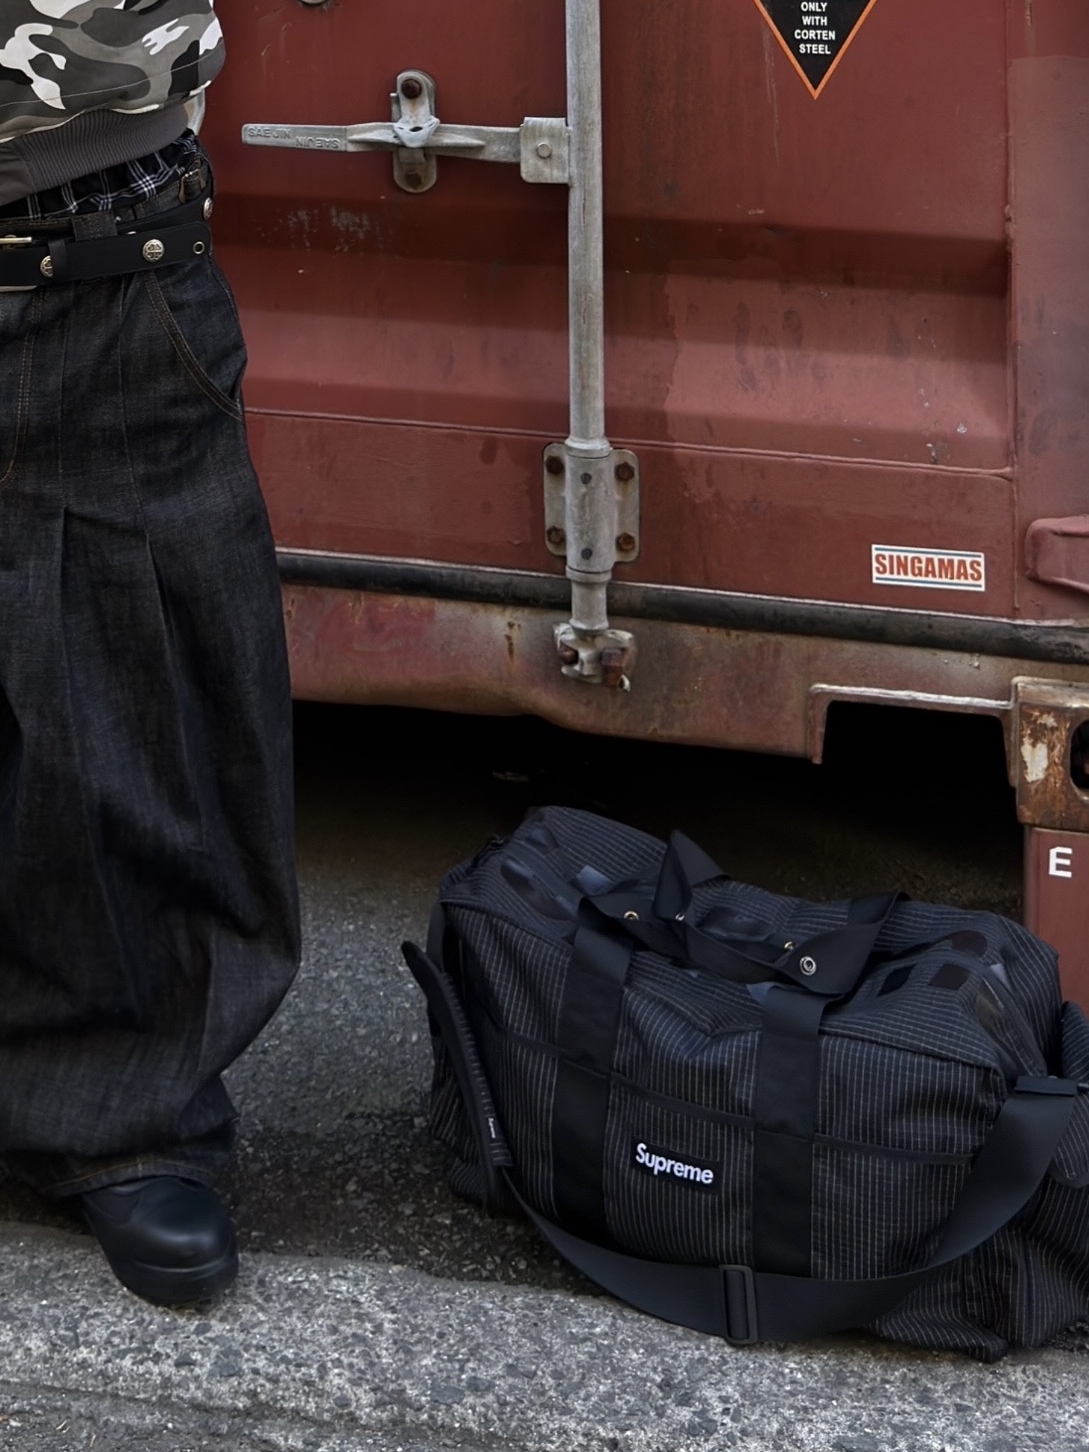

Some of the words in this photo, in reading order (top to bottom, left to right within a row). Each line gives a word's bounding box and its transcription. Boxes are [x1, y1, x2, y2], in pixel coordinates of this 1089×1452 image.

[801, 2, 827, 12] ONLY
[802, 16, 828, 26] WITH
[794, 30, 836, 40] CORTEN
[799, 43, 831, 54] STEEL
[875, 553, 982, 581] SINGAMAS
[1048, 846, 1073, 878] E
[635, 1142, 714, 1184] Supreme
